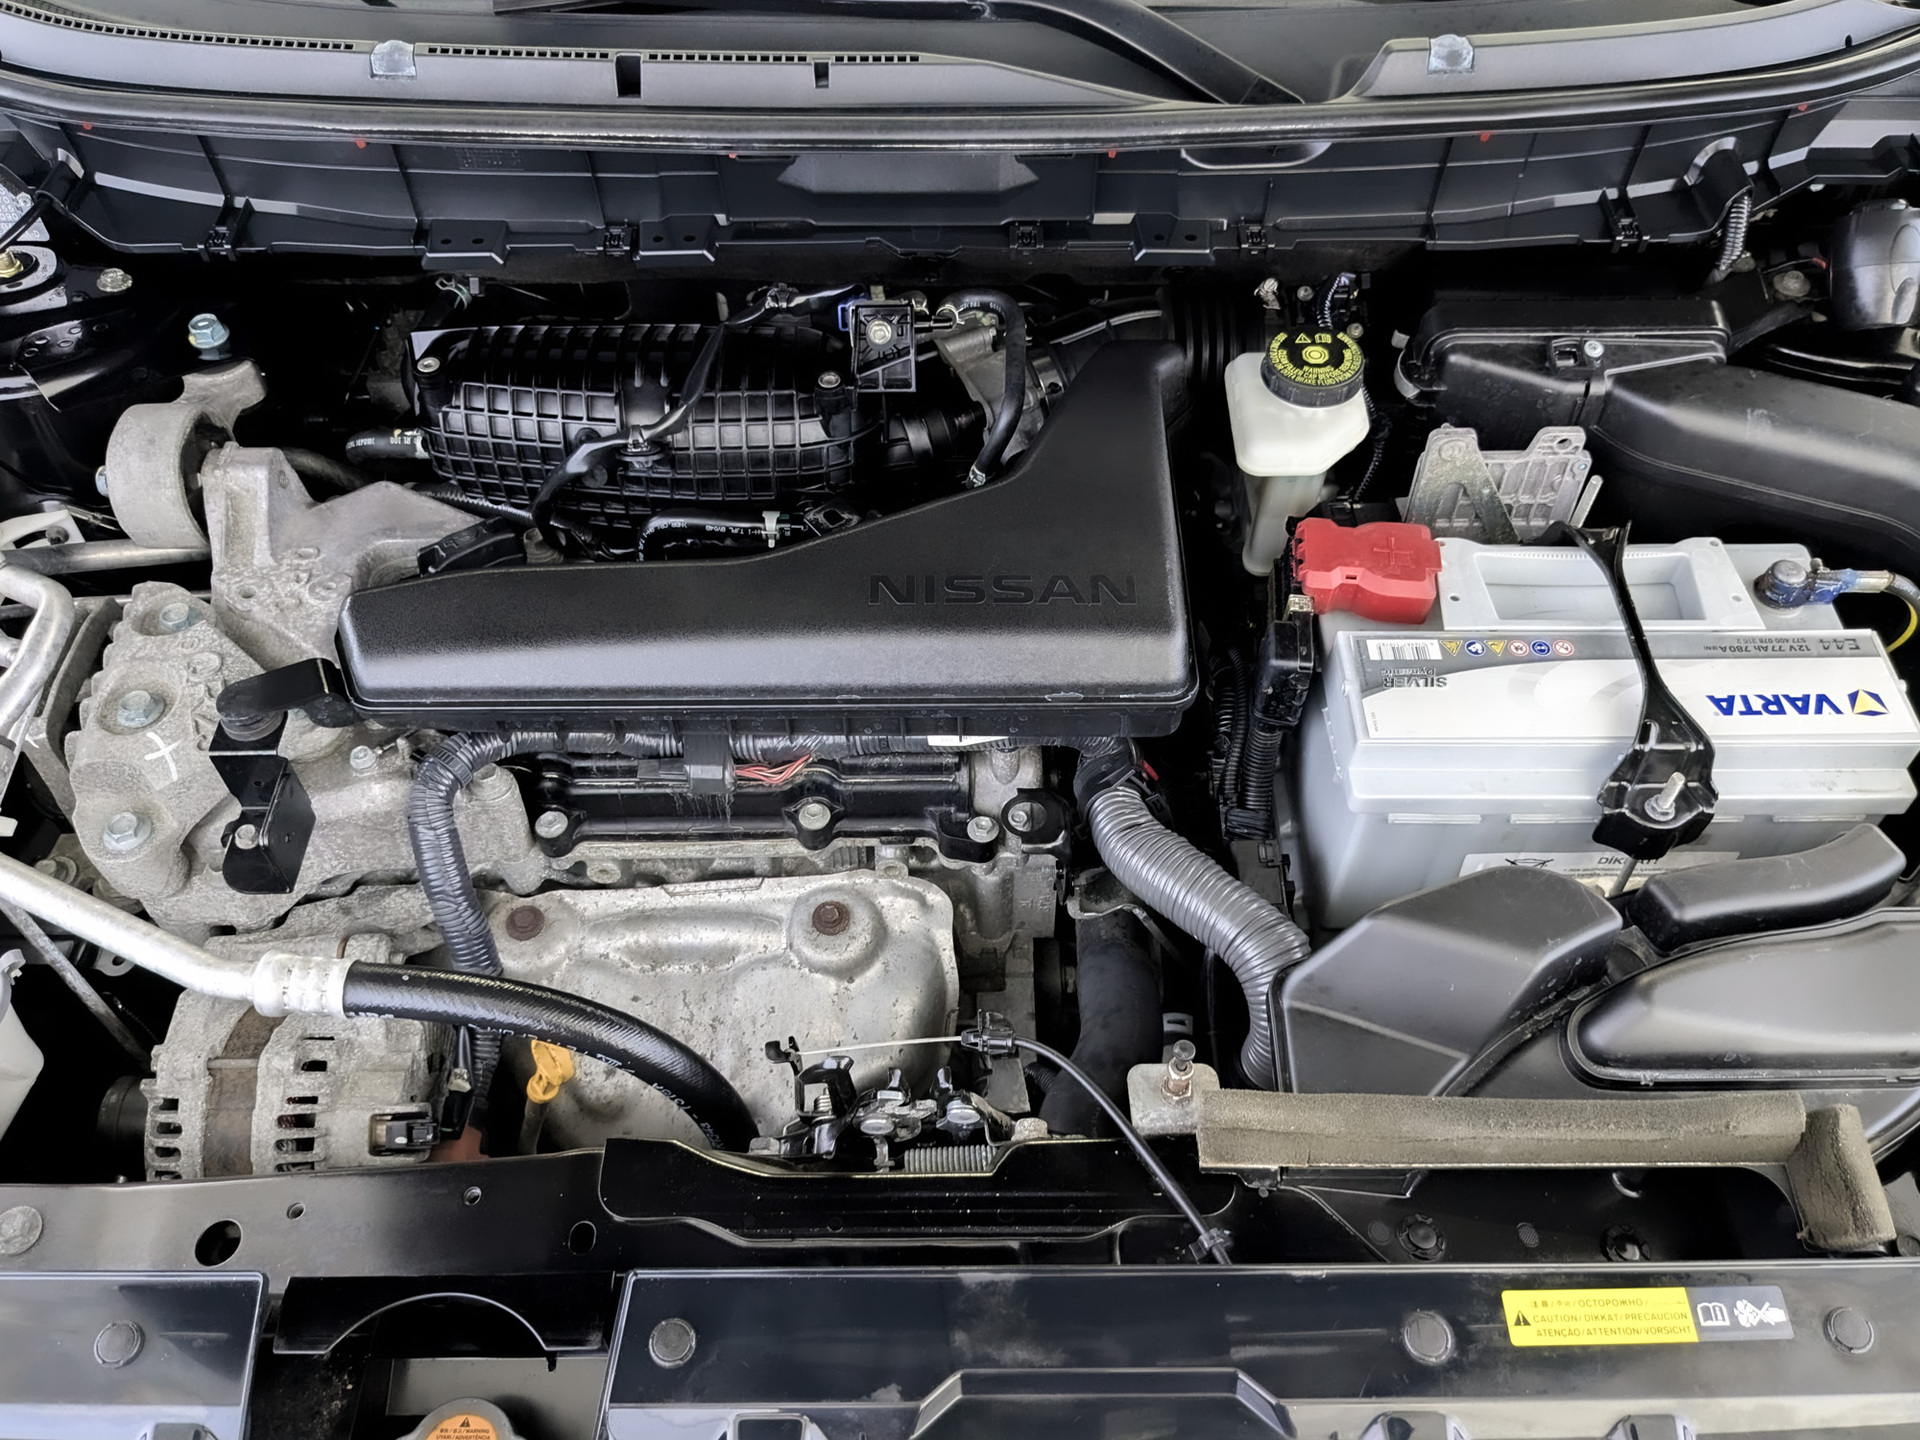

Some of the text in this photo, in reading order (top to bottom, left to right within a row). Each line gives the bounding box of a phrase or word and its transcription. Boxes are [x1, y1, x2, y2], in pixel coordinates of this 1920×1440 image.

[1294, 376, 1317, 386] BRAKE
[1317, 377, 1336, 386] FLUID
[868, 574, 1137, 606] NISSAN
[1788, 644, 1812, 652] 12V
[1819, 638, 1861, 651] E44
[1381, 667, 1436, 677] Dynamic
[1382, 676, 1447, 688] SILVER
[1705, 693, 1845, 716] VARTA
